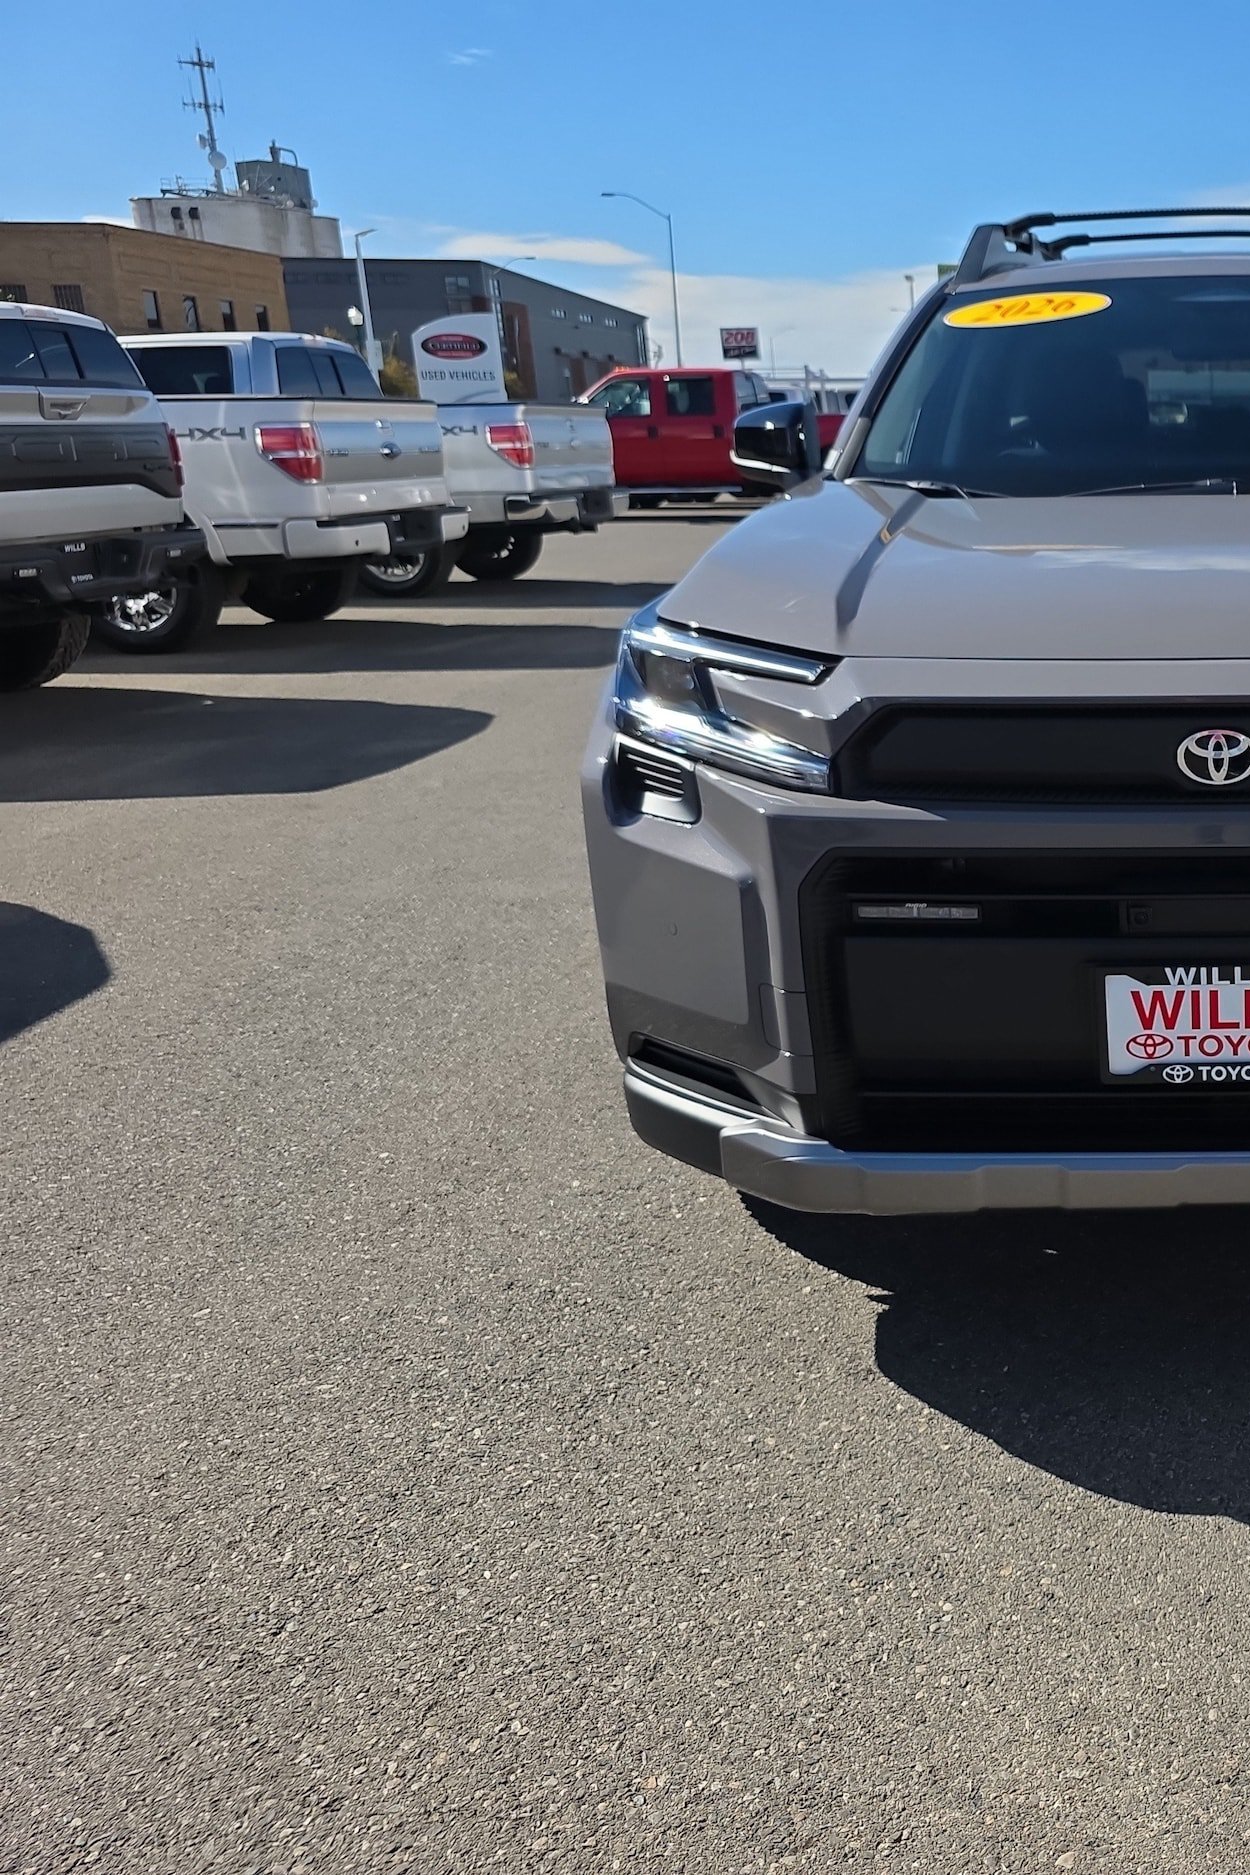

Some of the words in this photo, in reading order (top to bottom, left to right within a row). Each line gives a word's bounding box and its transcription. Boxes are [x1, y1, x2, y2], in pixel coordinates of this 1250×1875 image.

[969, 297, 1079, 324] 2026
[421, 370, 447, 381] USED
[448, 370, 496, 381] VEHICLES
[64, 543, 86, 553] WILLS
